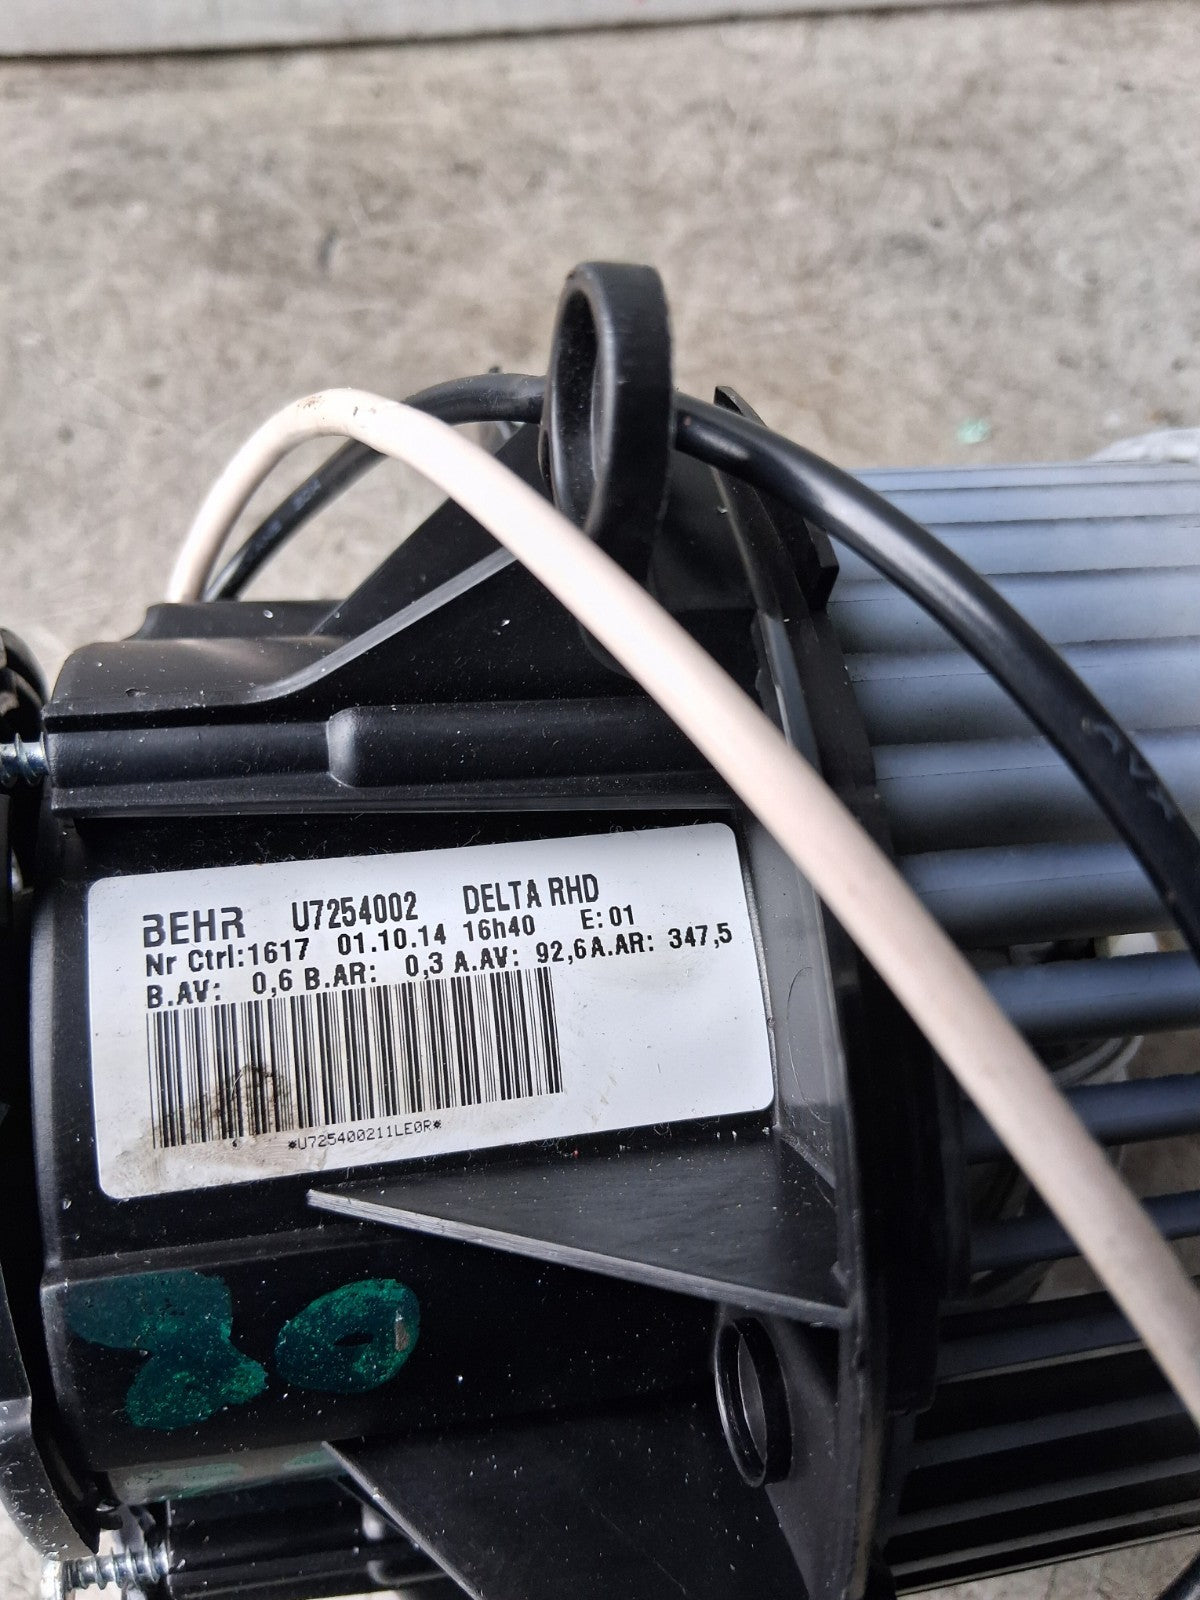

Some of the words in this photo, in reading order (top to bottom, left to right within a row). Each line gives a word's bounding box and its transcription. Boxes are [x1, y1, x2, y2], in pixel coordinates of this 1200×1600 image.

[142, 906, 246, 948] BEHR
[292, 891, 417, 932] U7254002
[463, 878, 541, 915] DELTA
[548, 874, 600, 906] RHD
[145, 954, 176, 977] Nr
[338, 920, 445, 955] 01.10.14
[463, 914, 536, 941] 16h40
[146, 977, 221, 1009] B.AV:
[252, 969, 293, 996] 0,6
[304, 962, 377, 991] B.AR:
[405, 952, 444, 980] 0,3
[454, 945, 520, 974] A.AV:
[667, 923, 732, 949] 347,5
